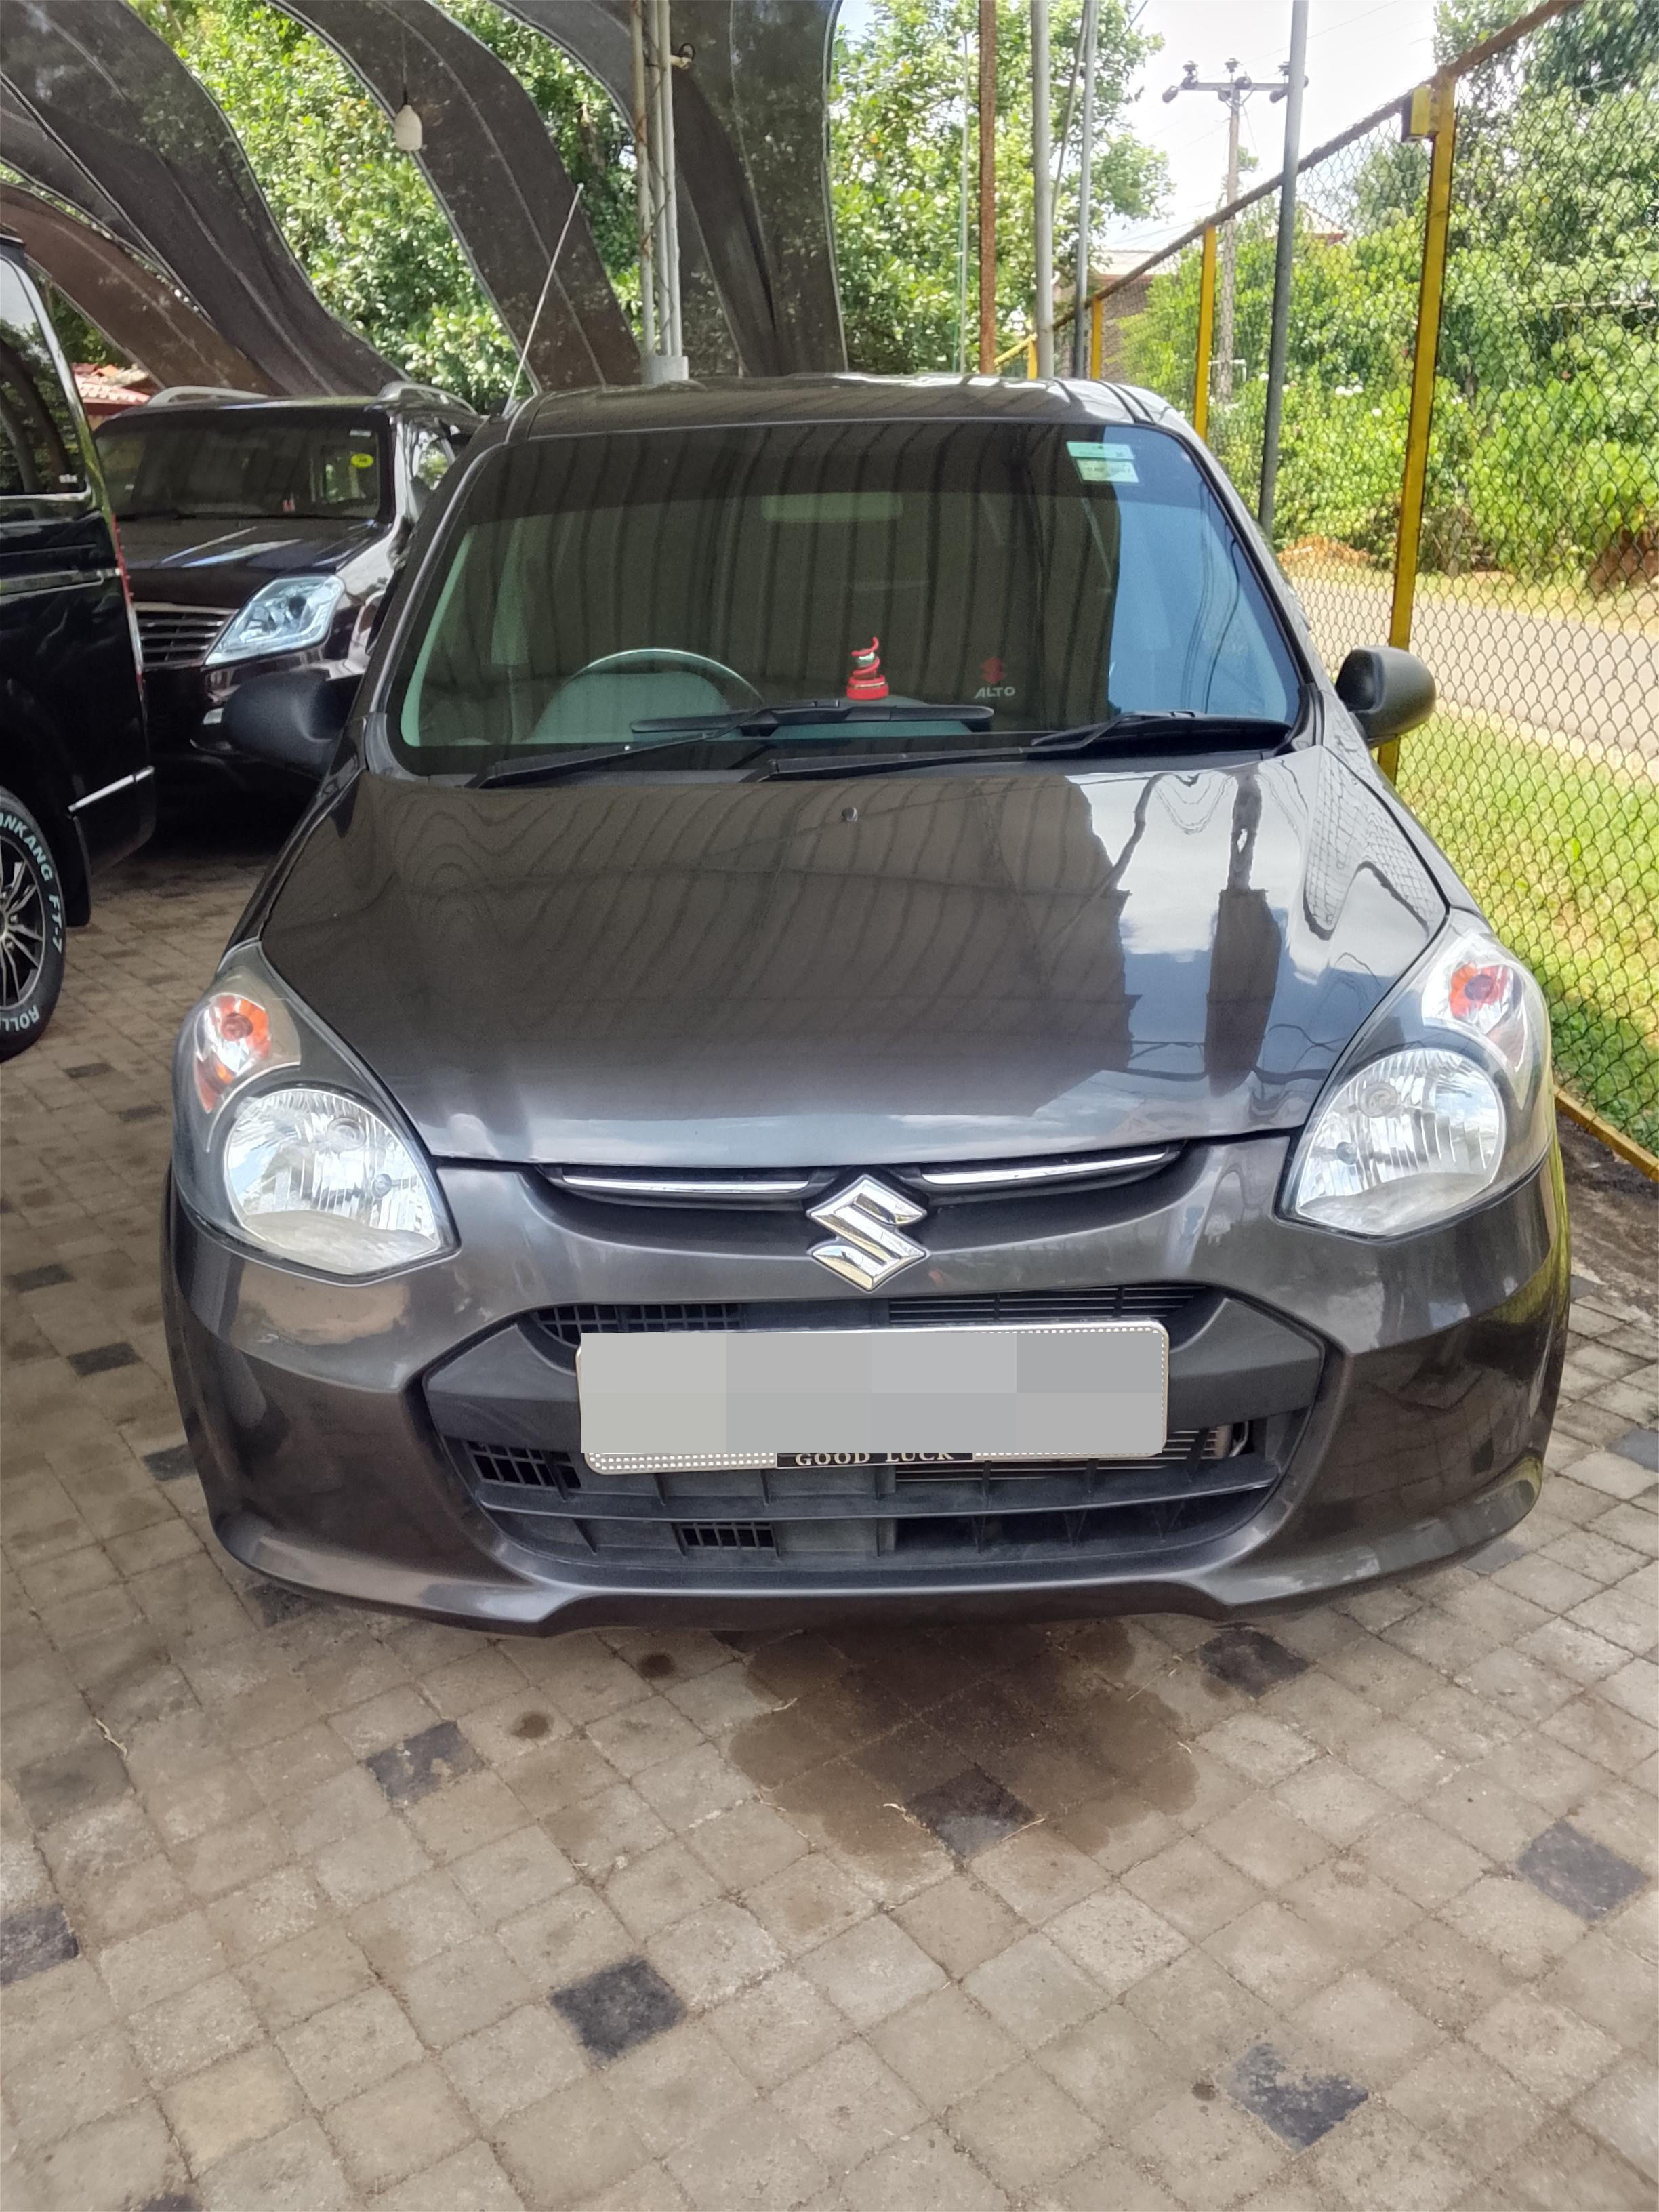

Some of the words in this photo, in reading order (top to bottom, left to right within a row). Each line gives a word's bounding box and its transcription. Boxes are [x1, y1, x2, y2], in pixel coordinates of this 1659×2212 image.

[974, 686, 1016, 699] ALTO
[49, 894, 63, 954] FT-7
[0, 1004, 40, 1031] ROLL
[795, 1452, 871, 1466] GOOD
